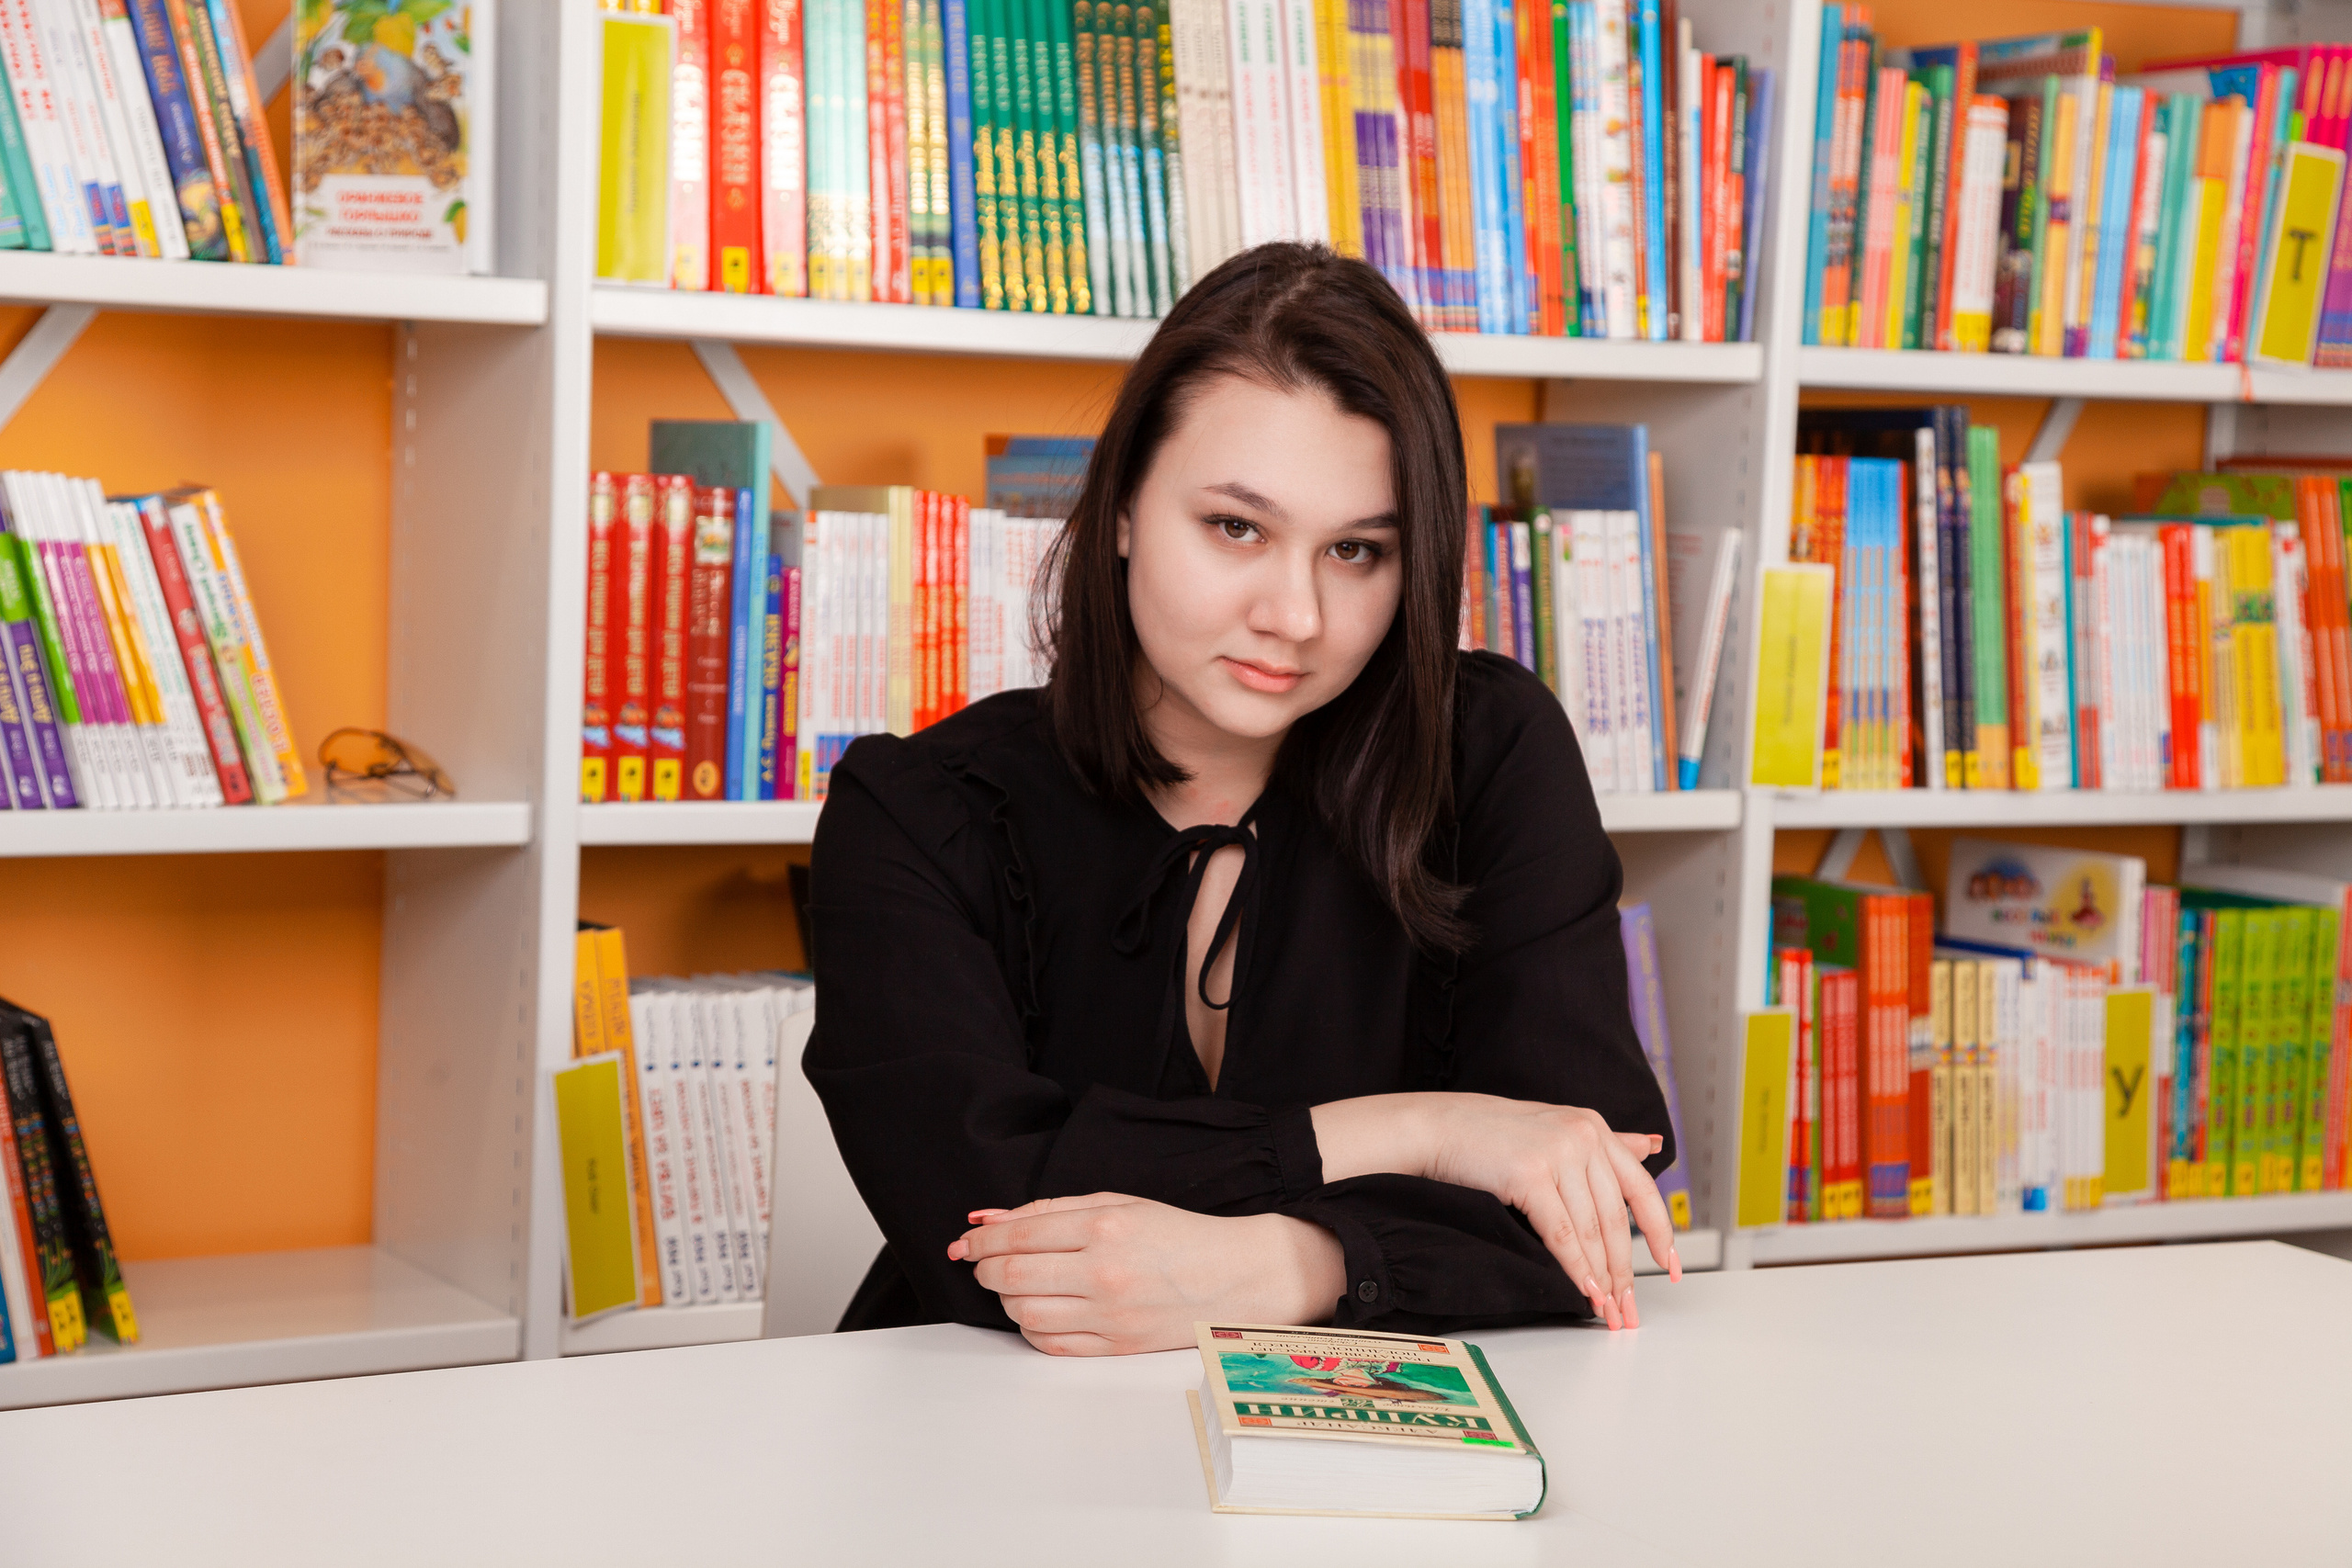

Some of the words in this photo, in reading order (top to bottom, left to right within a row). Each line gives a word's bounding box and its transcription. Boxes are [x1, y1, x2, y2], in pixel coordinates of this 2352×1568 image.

[720, 69, 751, 185] СКАЗКИ
[770, 74, 800, 191] СКАЗКИ
[2289, 228, 2318, 281] Т
[763, 613, 779, 689] СКАЗКИ
[2109, 1063, 2145, 1118] У
[1249, 1347, 1317, 1357] БРАСЛЕТ
[1322, 1350, 1431, 1363] ГРАНАТОВЫЙ
[1326, 1346, 1418, 1357] ПОЕДИНОК
[1248, 1404, 1478, 1428] КУПРИН
[1296, 1420, 1439, 1435] АЛЕКСАНДР
